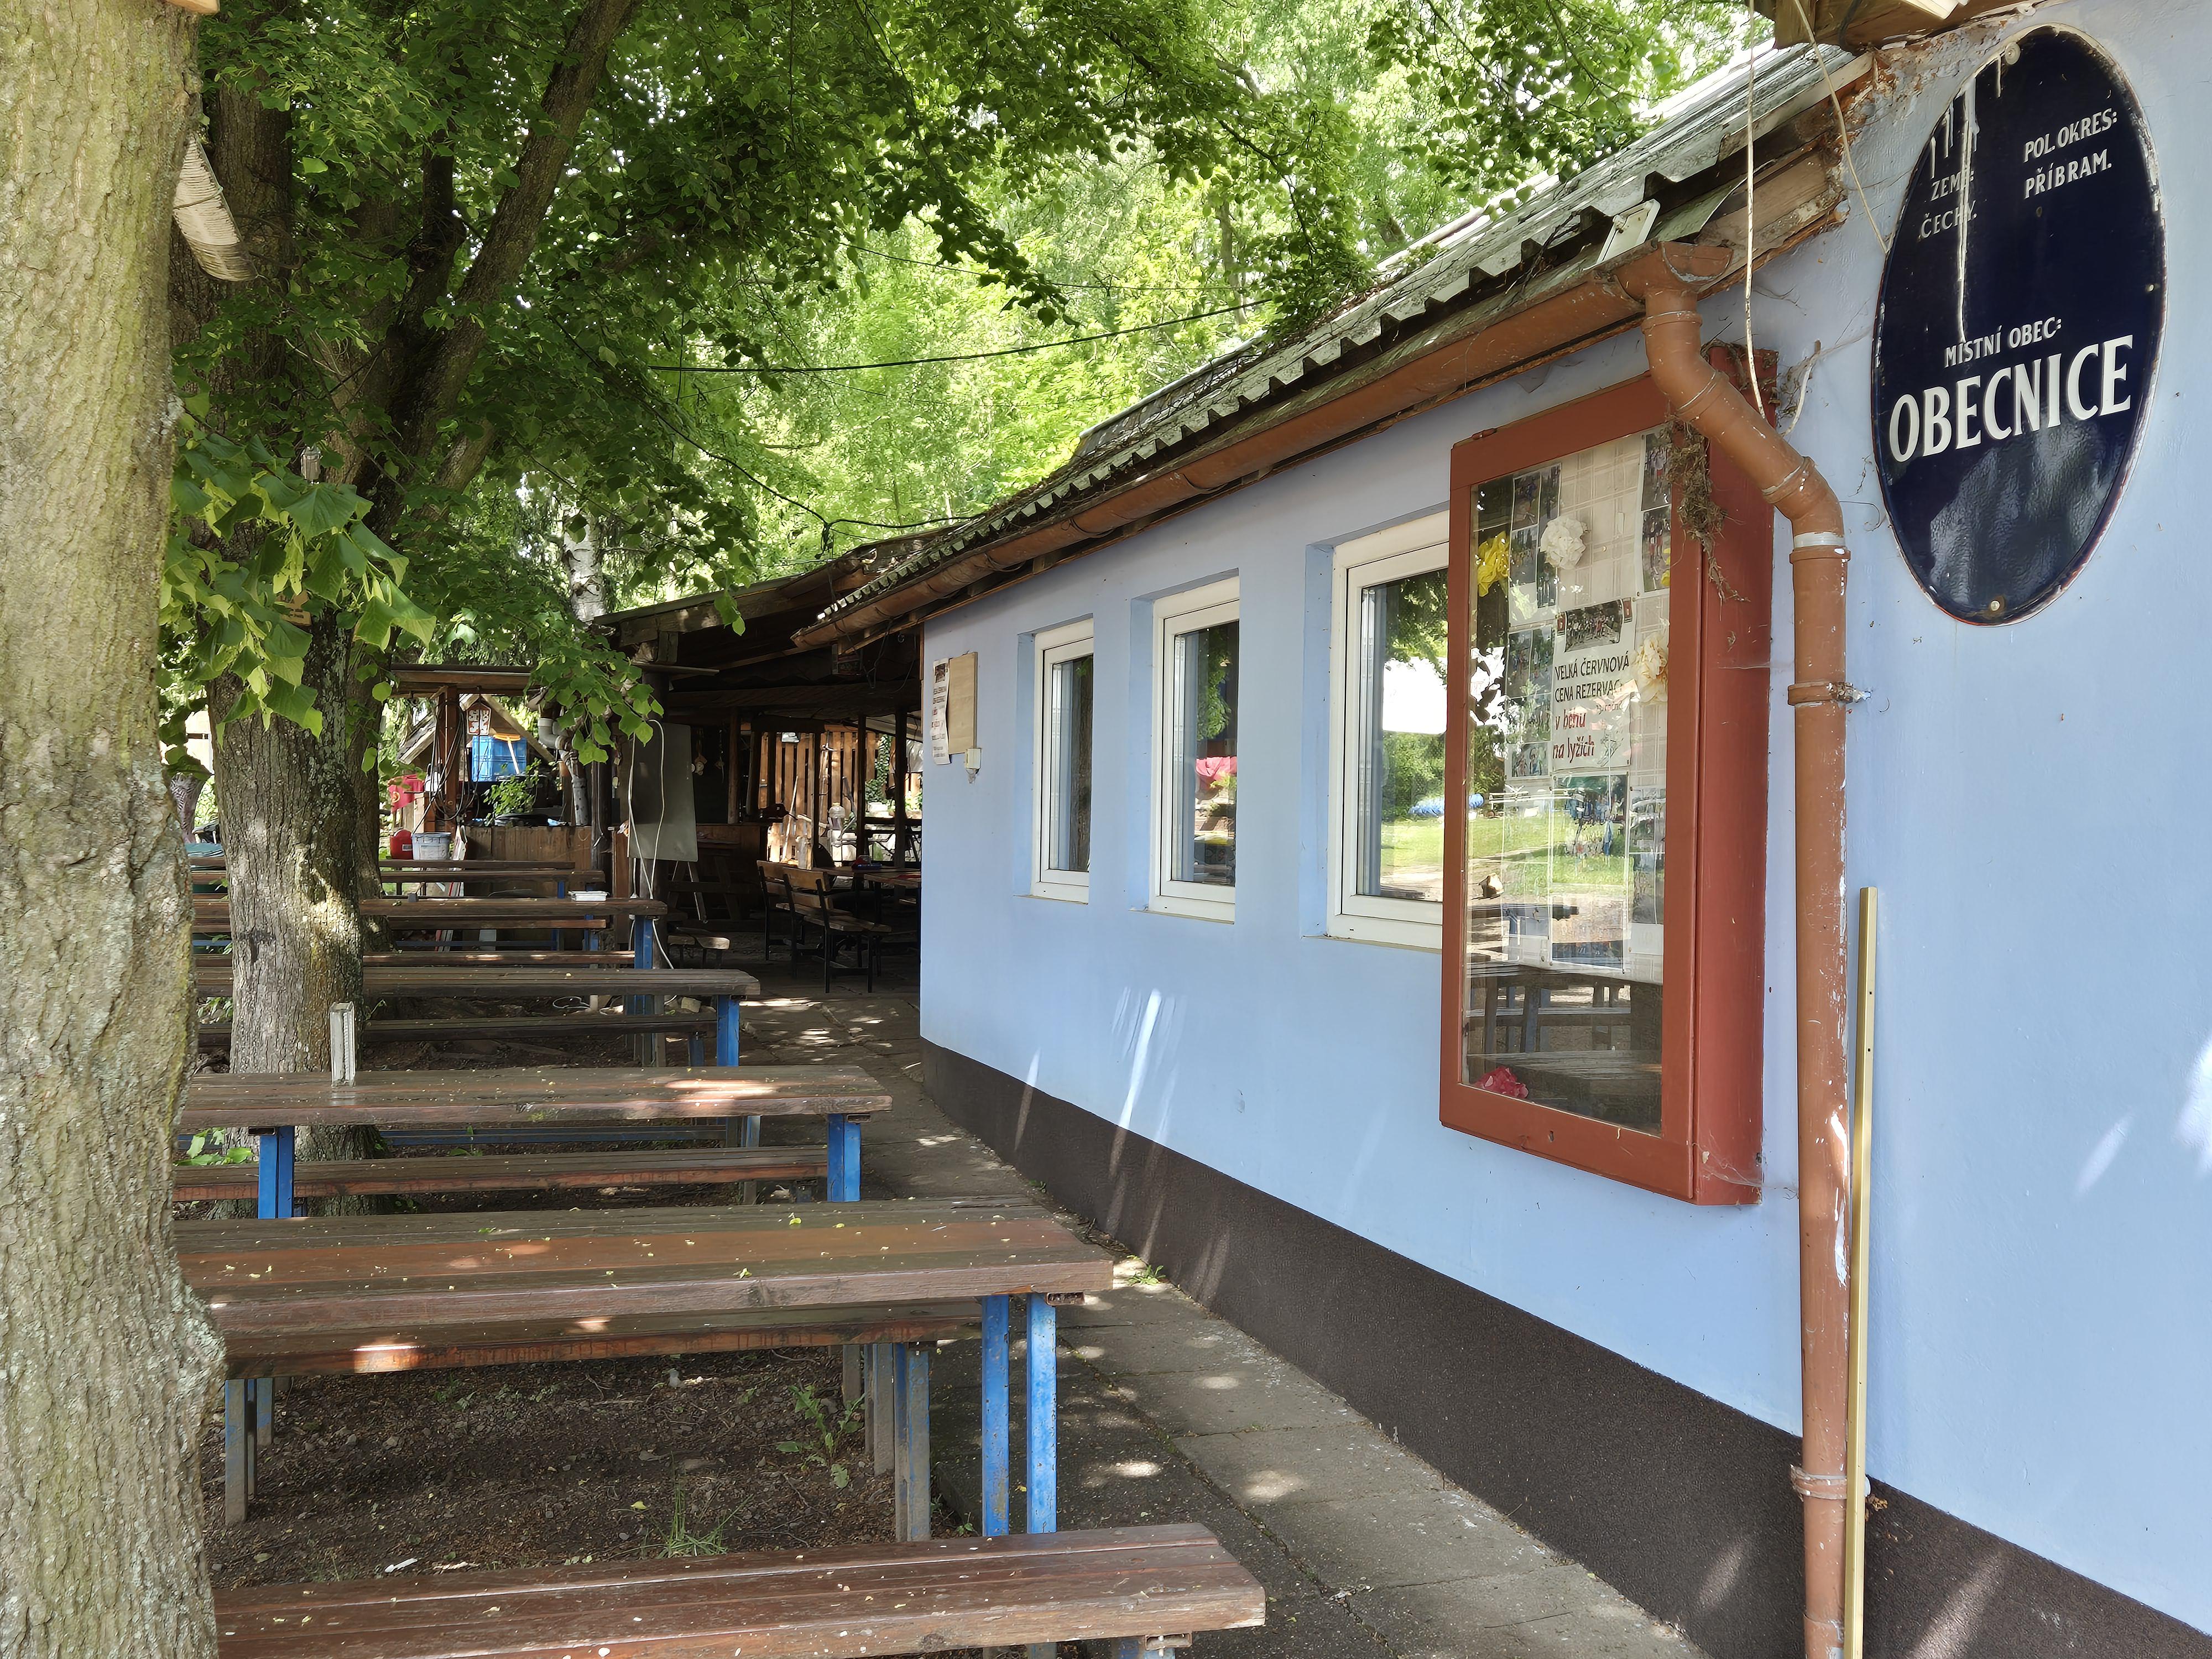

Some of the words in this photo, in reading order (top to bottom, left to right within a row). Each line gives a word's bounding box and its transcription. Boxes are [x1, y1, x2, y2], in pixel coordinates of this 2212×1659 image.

[2057, 108, 2117, 148] OKRES:
[1931, 169, 1974, 201] ZEM:
[2024, 149, 2112, 199] PŘÍBRAM.
[2008, 317, 2062, 348] OBEC:
[1889, 335, 2133, 462] OBECNICE
[1554, 659, 1578, 680] VELKÁ
[1580, 650, 1629, 676] ČERVNOVÁ
[1554, 687, 1574, 703] CENA
[1555, 715, 1560, 730] v
[1553, 744, 1564, 759] na
[1567, 735, 1595, 763] lyžích
